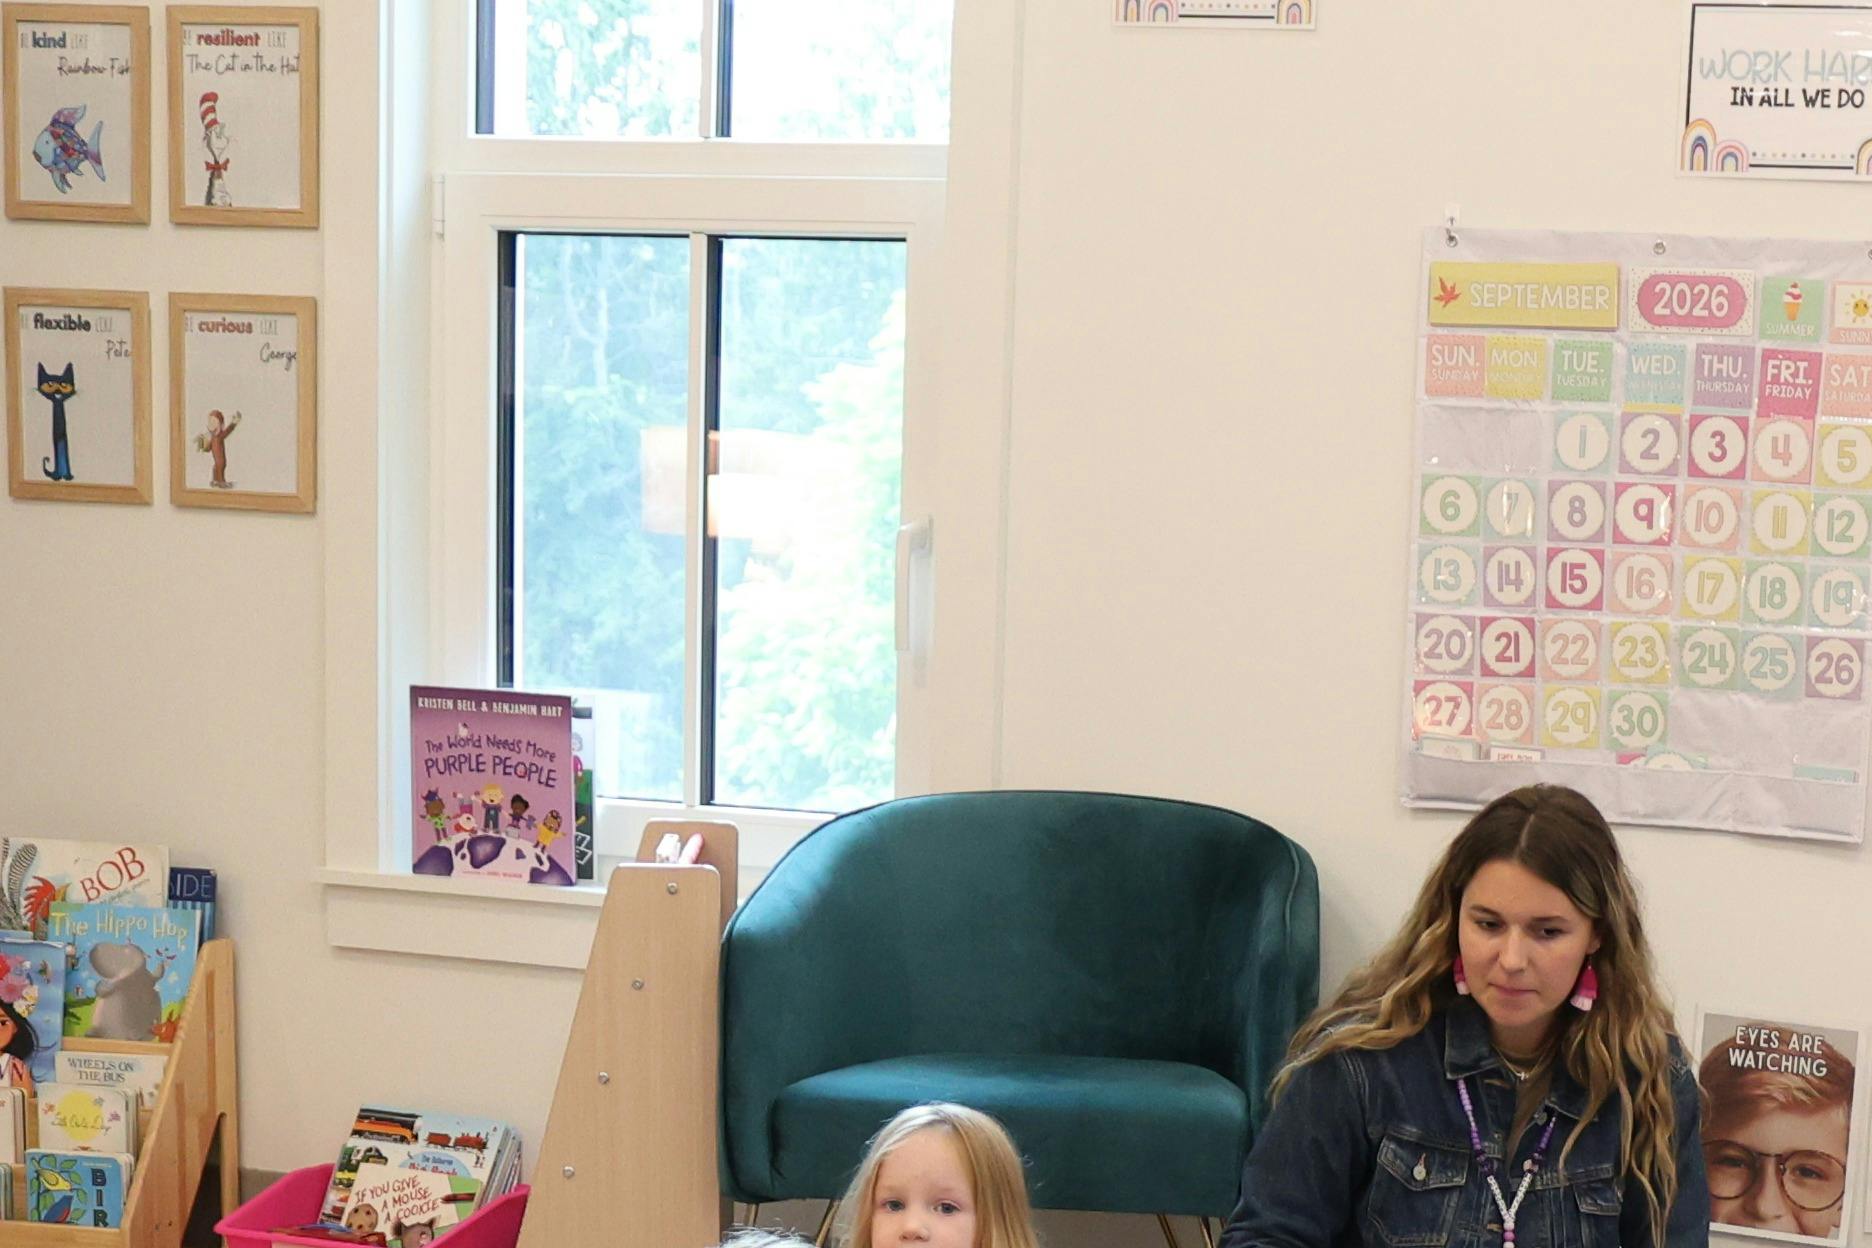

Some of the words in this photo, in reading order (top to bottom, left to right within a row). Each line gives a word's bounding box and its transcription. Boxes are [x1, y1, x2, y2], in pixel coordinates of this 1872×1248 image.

[32, 31, 66, 49] kind
[197, 29, 260, 46] resilient
[267, 31, 287, 46] LIKE
[58, 56, 106, 78] Rainbow
[186, 54, 212, 74] The
[215, 54, 236, 75] Cat
[240, 61, 253, 74] in
[254, 52, 276, 74] the
[1700, 50, 1792, 84] WORK
[1731, 86, 1753, 107] IN
[1759, 87, 1794, 107] ALL
[1802, 89, 1830, 108] WE
[1837, 89, 1865, 108] DO
[1470, 283, 1610, 310] SEPTEMBER
[1654, 282, 1729, 317] 2026
[33, 312, 91, 332] flexible
[198, 317, 253, 334] curious
[1765, 322, 1815, 337] SUMMER
[1431, 344, 1480, 367] SUN.
[1561, 351, 1604, 373] TUE.
[1630, 354, 1681, 376] WED.
[1701, 354, 1747, 379] THU.
[1766, 359, 1813, 385] FRI.
[1432, 369, 1479, 383] SUNDAY
[1556, 374, 1607, 387] TUESDAY
[1696, 380, 1750, 393] THURSDAY
[1765, 384, 1813, 399] FRIDAY
[1578, 425, 1587, 458] 1
[1639, 428, 1660, 460] 2
[1708, 430, 1727, 462] 3
[1771, 434, 1792, 467] 4
[1837, 439, 1857, 473] 5
[1440, 489, 1461, 521] 6
[1504, 492, 1519, 524] 7
[1567, 495, 1587, 528] 8
[1633, 498, 1654, 530] 9
[1695, 500, 1724, 534] 10
[1772, 506, 1788, 539] 11
[1826, 509, 1855, 543] 12
[1433, 558, 1461, 591] 13
[1497, 560, 1524, 593] 14
[1560, 561, 1587, 594] 15
[1626, 566, 1655, 599] 16
[1697, 571, 1724, 605] 17
[1759, 576, 1787, 609] 18
[1824, 580, 1853, 614] 19
[1423, 628, 1466, 661] 20
[1494, 631, 1520, 663] 21
[1550, 633, 1590, 666] 22
[1618, 635, 1659, 668] 23
[1687, 641, 1729, 675] 24
[1750, 647, 1789, 681] 25
[1814, 651, 1854, 685] 26
[418, 697, 454, 710] KRISTEN
[457, 700, 476, 712] BELL
[480, 702, 488, 712] &
[492, 702, 537, 715] BENJAMIN
[541, 706, 562, 717] HART
[1423, 695, 1462, 727] 27
[1485, 698, 1523, 730] 28
[1551, 701, 1591, 734] 29
[1615, 703, 1659, 738] 30
[425, 740, 443, 752] The
[447, 735, 481, 749] World
[486, 735, 521, 753] Needs
[526, 740, 556, 763] More
[425, 753, 486, 778] PURPLE
[492, 755, 557, 788] PEOPLE
[80, 847, 145, 902] BOB
[51, 912, 88, 936] The
[96, 909, 147, 938] Hippo
[153, 911, 187, 951] Hop
[1736, 1026, 1780, 1049] EYES
[1788, 1033, 1824, 1055] ARE
[67, 1057, 115, 1072] WHEELS
[118, 1061, 134, 1072] ON
[1728, 1047, 1828, 1077] WATCHING
[77, 1070, 99, 1081] THE
[103, 1072, 125, 1083] BUS
[355, 1188, 367, 1203] IF
[369, 1181, 390, 1198] YOU
[392, 1175, 420, 1192] GIVE
[381, 1200, 388, 1213] A
[392, 1187, 432, 1207] MOUSE
[384, 1211, 390, 1223] A
[397, 1198, 440, 1220] COOKIE
